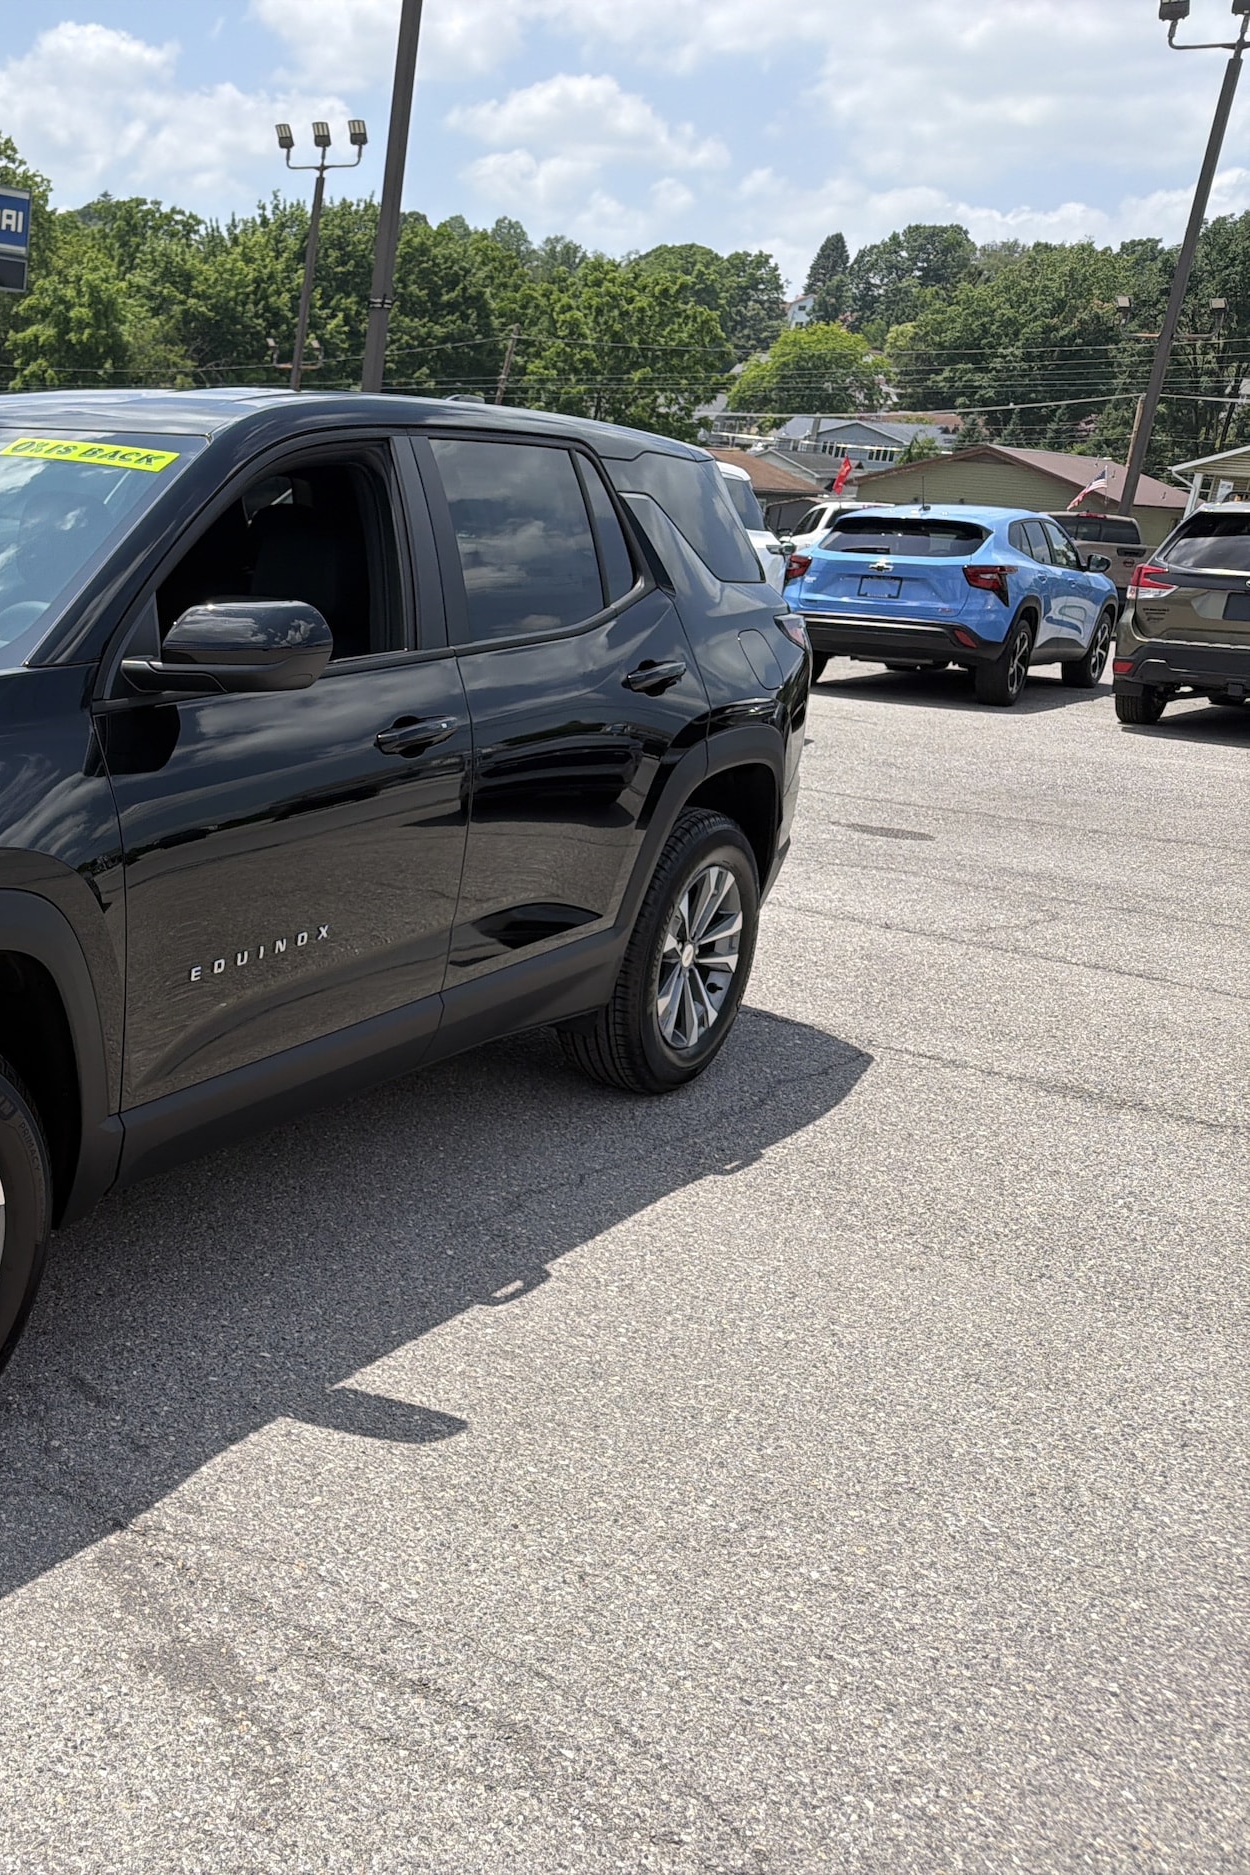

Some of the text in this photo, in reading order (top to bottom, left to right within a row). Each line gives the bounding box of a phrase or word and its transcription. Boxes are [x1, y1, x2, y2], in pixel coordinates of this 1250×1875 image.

[78, 447, 165, 466] BACK
[189, 924, 329, 982] EQUINOX
[19, 1121, 41, 1171] PRIMACY
